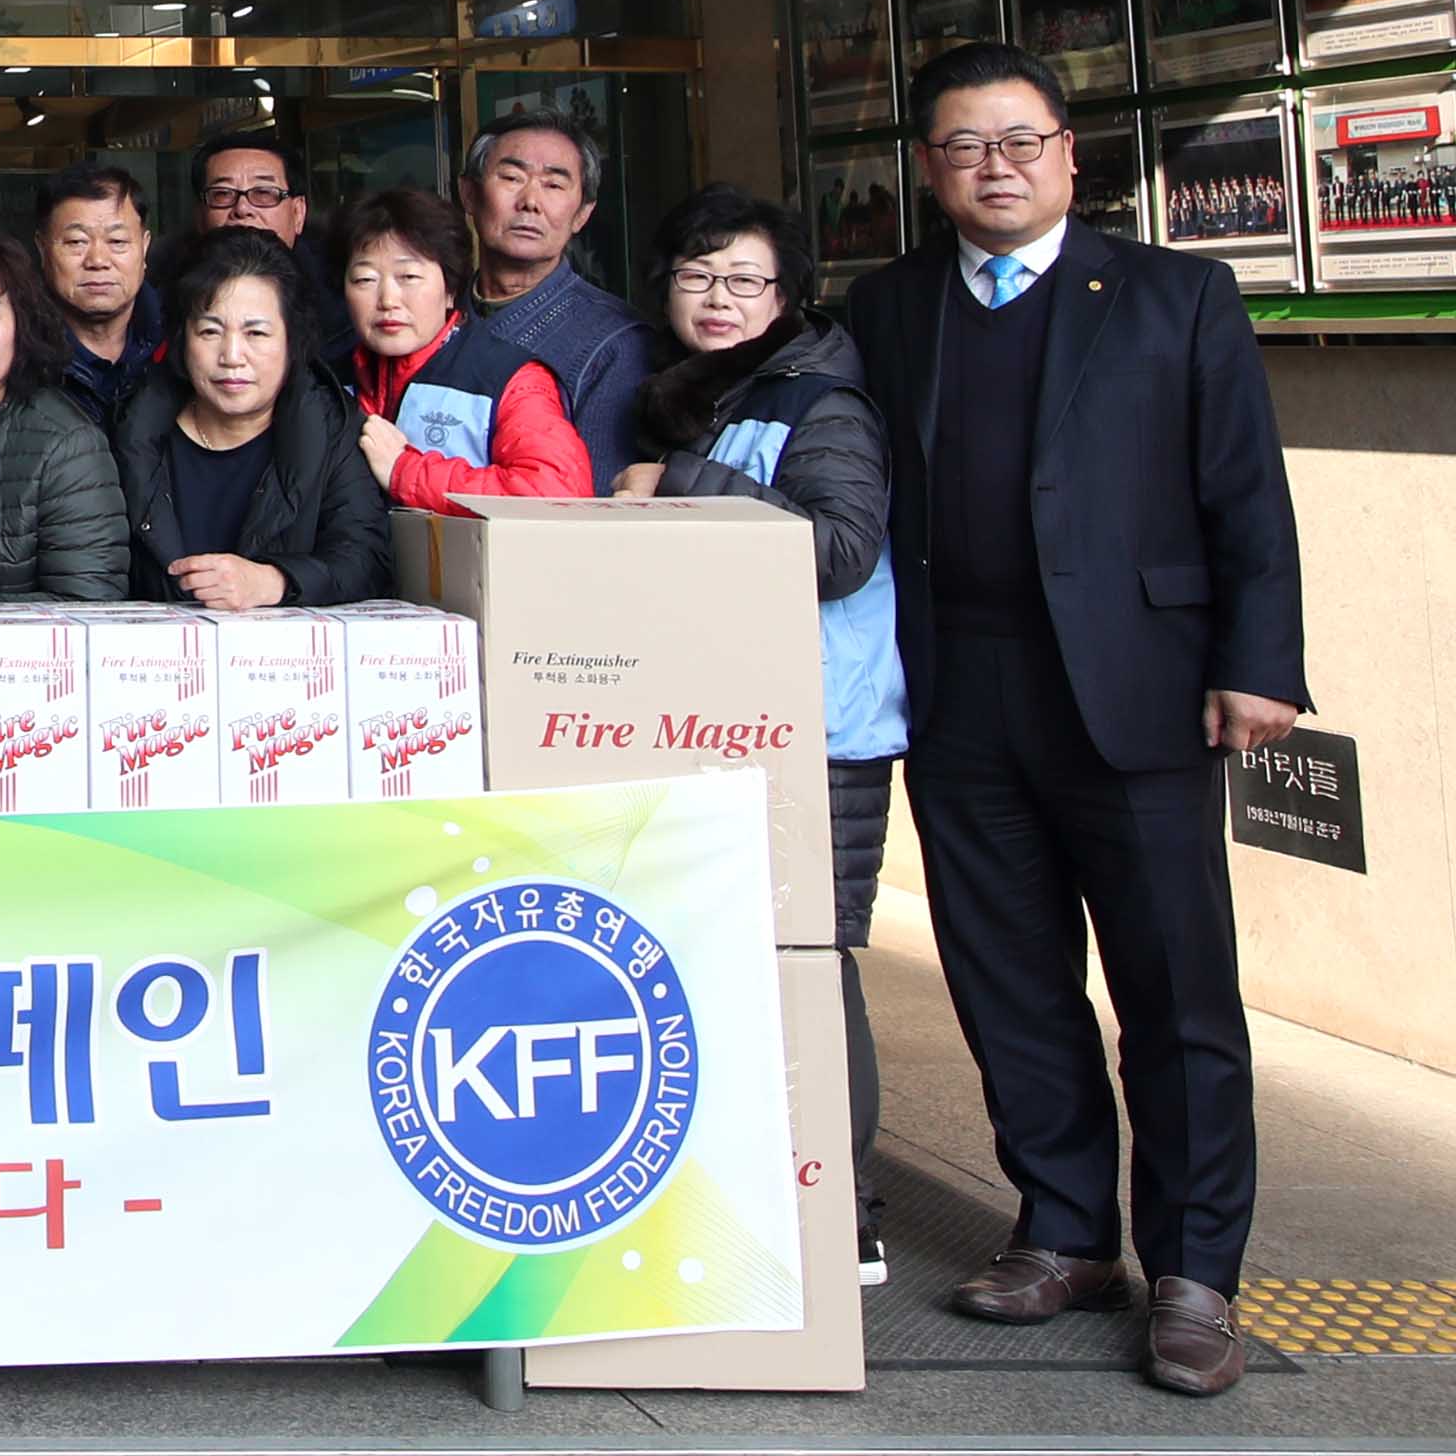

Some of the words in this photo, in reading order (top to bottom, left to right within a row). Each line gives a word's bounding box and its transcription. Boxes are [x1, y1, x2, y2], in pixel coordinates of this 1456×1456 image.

[101, 654, 126, 667] Fire
[229, 653, 254, 666] Fire
[360, 652, 385, 665] Fire
[512, 651, 543, 667] Fire
[546, 651, 640, 669] Extinguisher
[533, 671, 568, 685] 투척용
[575, 671, 622, 686] 소화용구
[101, 709, 168, 752] Fire
[117, 713, 212, 776] Magic
[229, 708, 296, 751] Fire
[245, 712, 340, 775] Magic
[360, 707, 427, 750] Fire
[376, 711, 471, 774] Magic
[538, 711, 635, 749] Fire
[652, 713, 795, 760] Magic
[1240, 747, 1341, 801] 머릿돌
[398, 887, 665, 990] 한국자유총연맹
[427, 1017, 640, 1123] KFF
[375, 1030, 429, 1164] KOREA
[416, 1154, 581, 1238] FREEDOM
[583, 1013, 691, 1223] FEDERATION
